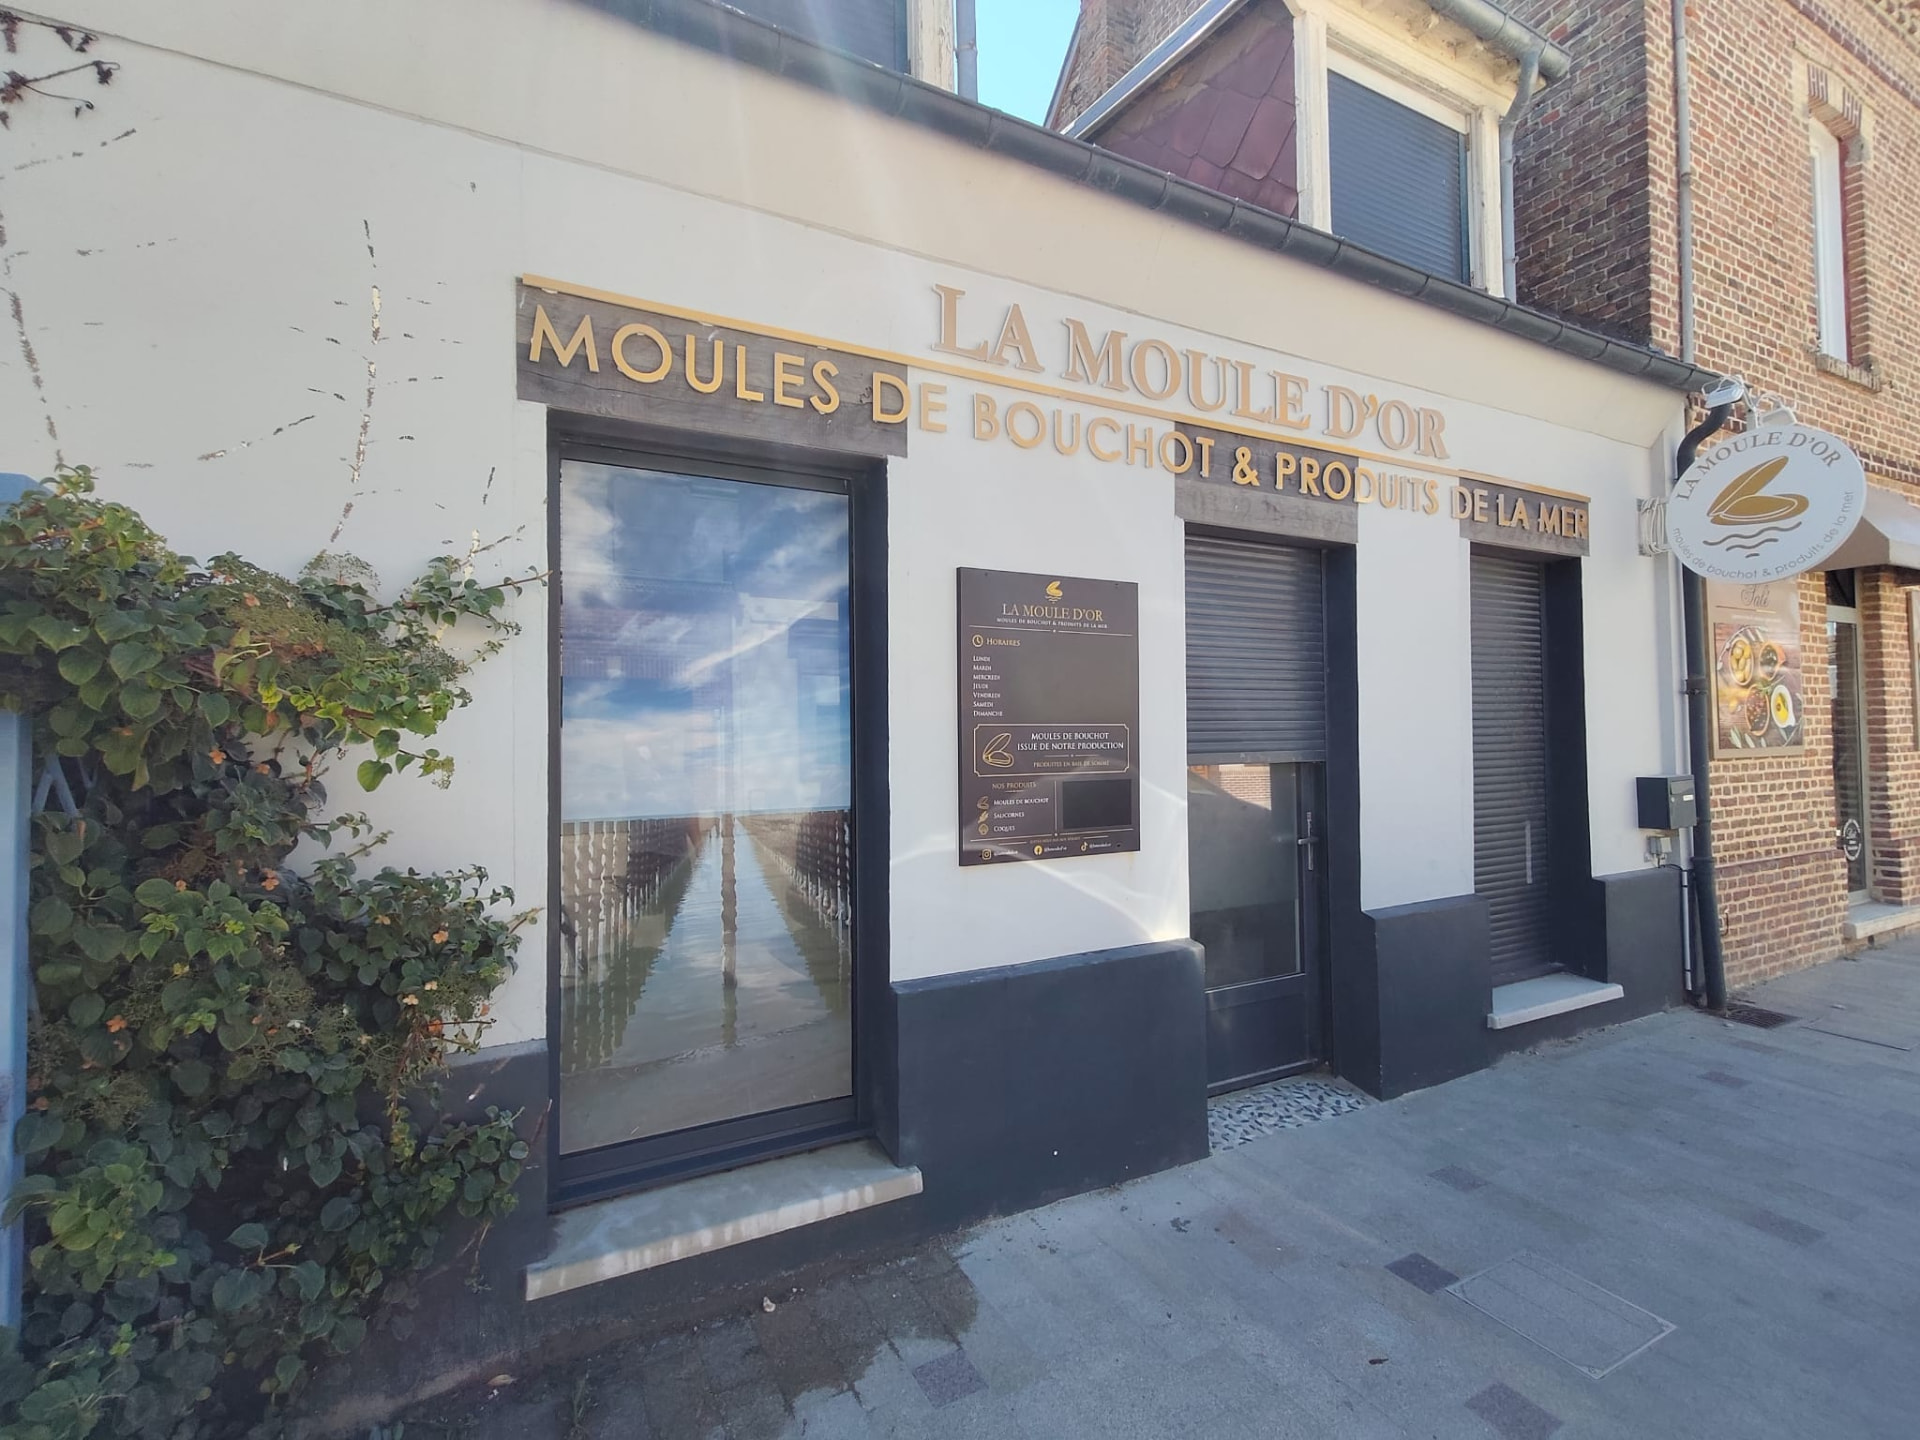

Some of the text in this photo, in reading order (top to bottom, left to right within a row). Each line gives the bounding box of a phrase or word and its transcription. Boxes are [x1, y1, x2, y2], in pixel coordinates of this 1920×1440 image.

[931, 283, 1045, 373] LA
[1061, 317, 1311, 430] MOULE
[528, 303, 840, 415] MOULES
[872, 371, 948, 433] DE
[973, 392, 1215, 478] BOUCHOT
[1232, 446, 1260, 486] &
[1275, 452, 1440, 516] PRODUITS
[1450, 485, 1489, 523] DE
[1496, 493, 1530, 530] LA
[1538, 501, 1588, 539] MER
[1676, 477, 1701, 501] LA
[1699, 431, 1783, 477] MOULE
[1672, 490, 1855, 579] moules de bouchot & produits de la mer
[1002, 603, 1020, 616] LA
[1023, 605, 1070, 619] MOULE
[1017, 743, 1038, 751] ISSUE
[1039, 743, 1049, 751] DE
[1077, 741, 1124, 750] PRODUCTION
[1031, 732, 1109, 741] MOULES DE BOUCHOT
[1006, 781, 1037, 789] PRODUITS
